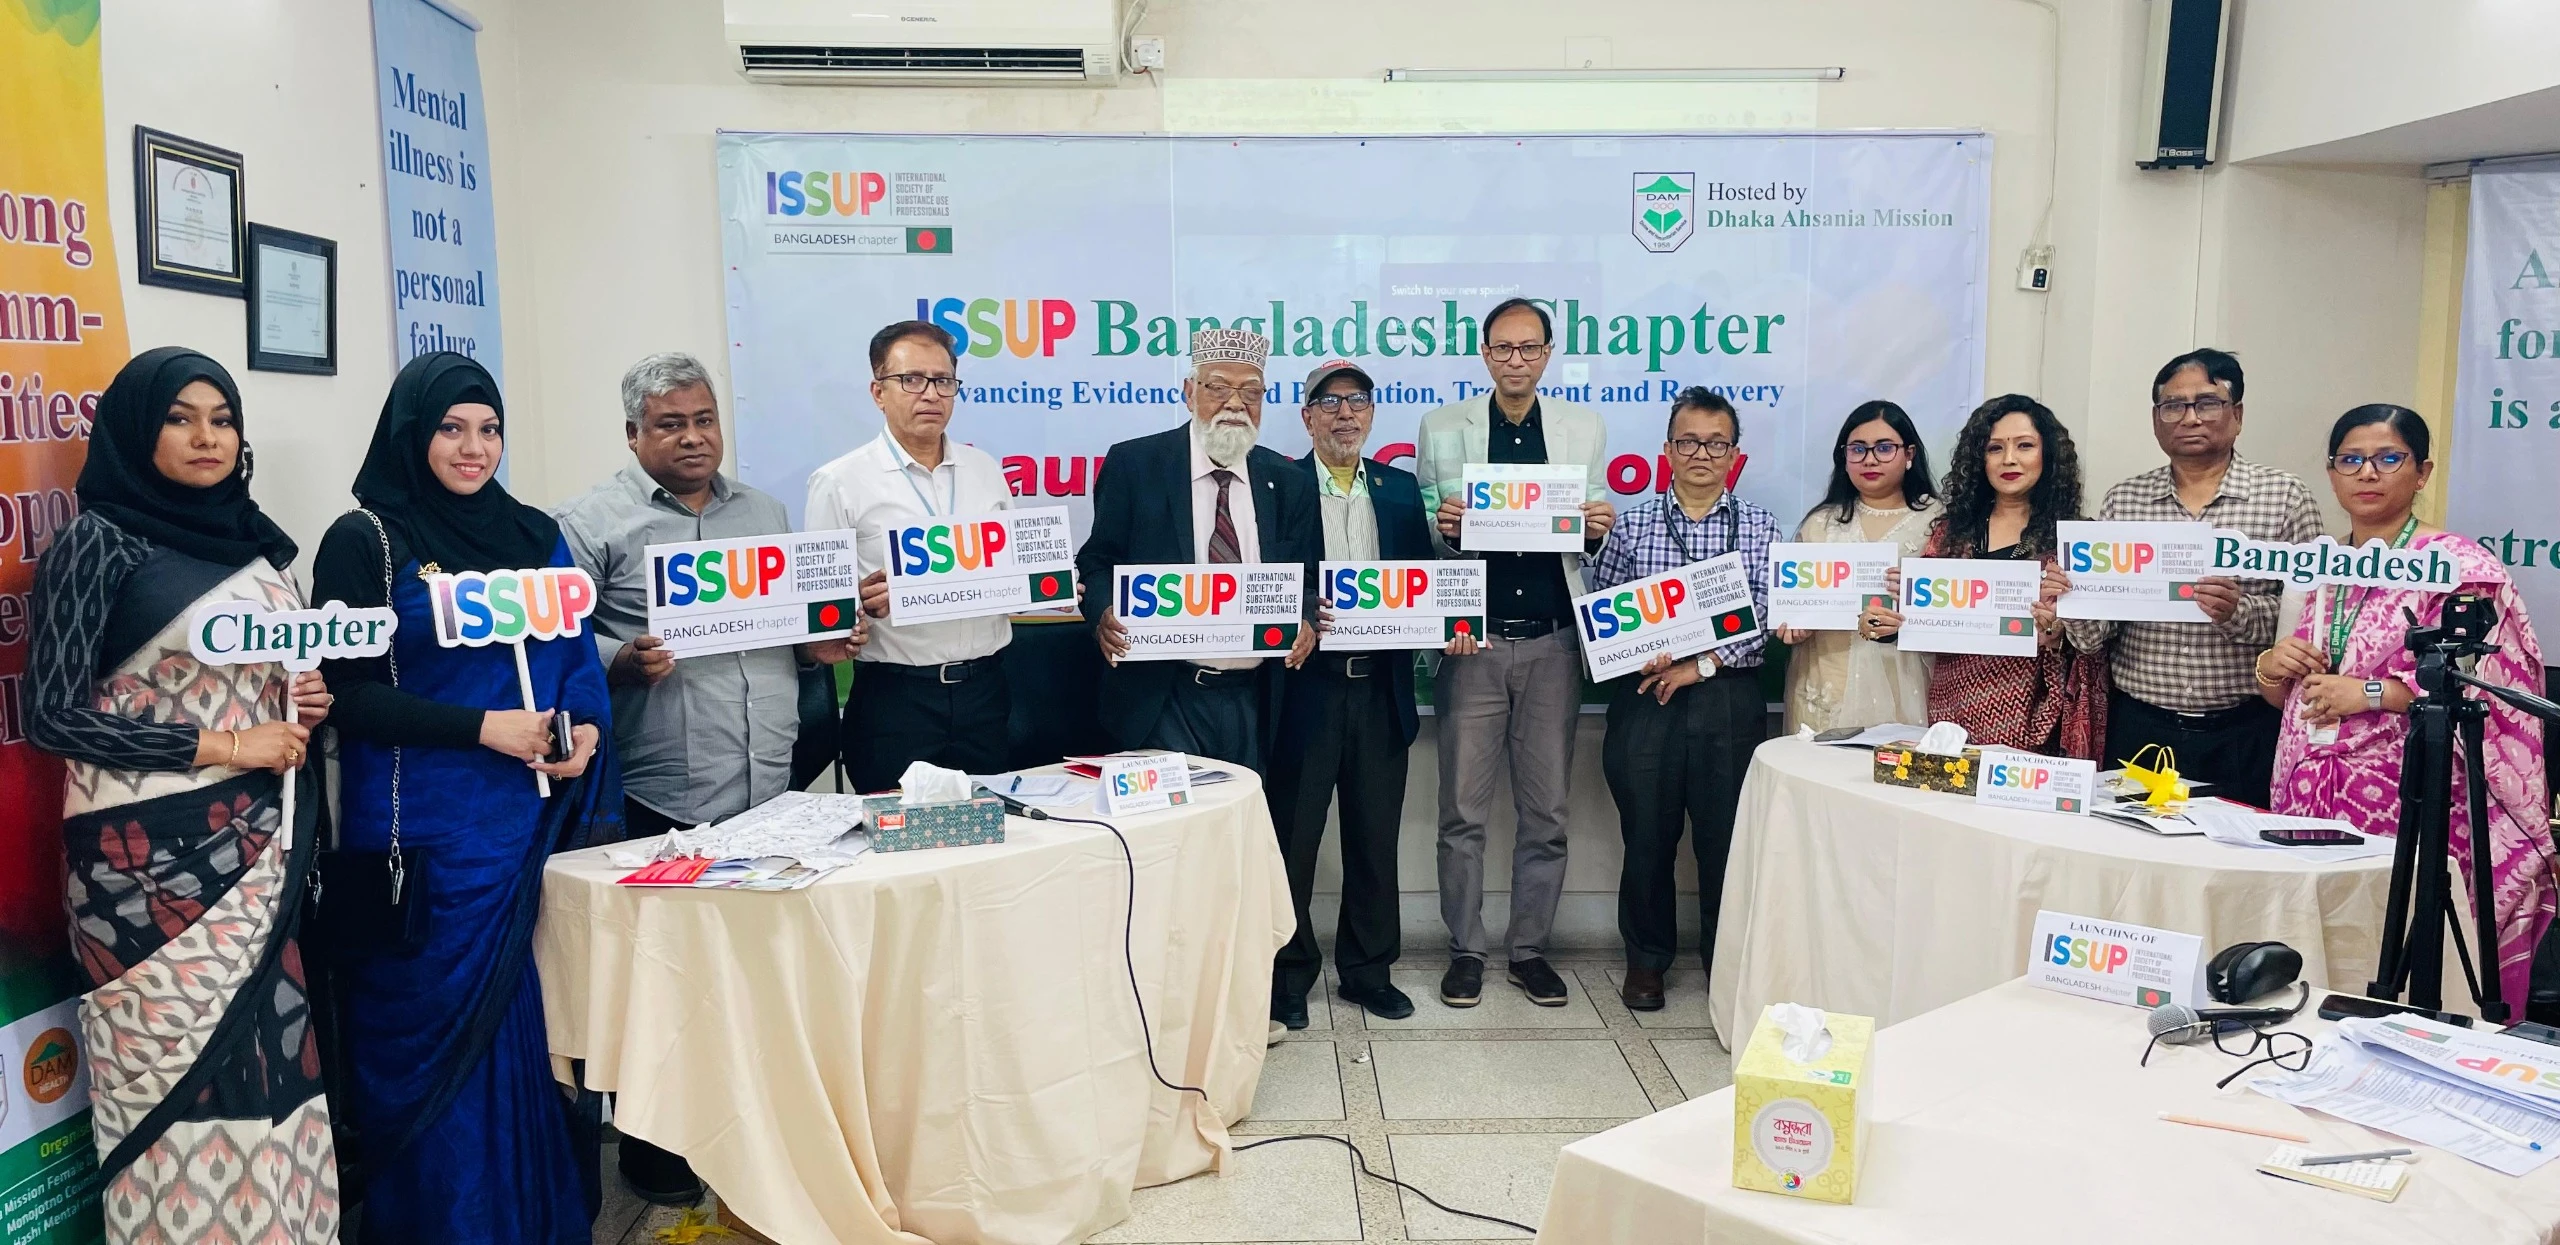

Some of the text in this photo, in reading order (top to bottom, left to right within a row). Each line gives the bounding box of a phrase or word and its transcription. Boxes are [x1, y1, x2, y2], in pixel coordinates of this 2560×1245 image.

[391, 66, 467, 130] Mental
[389, 129, 476, 190] illness is
[895, 172, 947, 182] INTERNATIONAL
[767, 171, 886, 216] ISSUP
[896, 184, 933, 194] SOCIETY OF
[1646, 193, 1680, 201] DAM
[1708, 182, 1807, 205] Hosted by
[896, 196, 949, 205] SUBSTANCE USE
[896, 207, 949, 217] PROFESSIONALS
[1707, 208, 1953, 228] Dhaka Ahsania Mission
[412, 208, 462, 245] not a
[774, 233, 898, 247] BANGLADESH chapter
[396, 269, 485, 309] personal
[1391, 284, 1421, 296] Switch
[1423, 286, 1434, 296] to
[1435, 287, 1457, 298] your
[1459, 287, 1477, 296] new
[410, 321, 476, 361] failure
[1092, 300, 1480, 358] Baladesh
[1524, 298, 1785, 372] hapter
[1601, 379, 1649, 402] and
[2488, 388, 2528, 429] is
[1467, 482, 1541, 510] ISSUP
[1014, 516, 1062, 528] INTERNATIONAL
[1470, 520, 1521, 528] BANGLADESH
[1016, 529, 1051, 541] SOCIETY OF
[795, 540, 849, 554] INTERNATIONAL
[889, 521, 1006, 576] ISSUP
[1017, 539, 1067, 552] SUBSTANCE USE
[2162, 543, 2203, 551] INTERNATIONAL
[796, 553, 836, 567] SOCIETY OF
[1018, 550, 1068, 563] PROFESSIONALS
[2063, 542, 2154, 574] ISSUP
[2213, 536, 2452, 585] Bangladesh
[654, 545, 785, 607] ISSUP
[797, 565, 852, 580] SUBSTANCE USE
[1246, 573, 1296, 582] INTERNATIONAL
[1437, 568, 1480, 577] INTERNATIONAL
[1691, 561, 1737, 581] INTERNATIONAL
[1774, 561, 1851, 589] ISSUP
[2162, 567, 2205, 576] PROFESSIONALS
[797, 577, 853, 592] PROFESSIONALS
[1246, 583, 1283, 593] SOCIETY OF
[1325, 568, 1429, 610] ISSUP
[1437, 579, 1469, 588] SOCIETY OF
[1693, 574, 1727, 590] SOCIETY OF
[1695, 582, 1743, 601] SUBSTANCE USE
[2131, 586, 2163, 595] chapter
[902, 585, 1022, 607] BANGLADESH chapter
[1120, 574, 1237, 618] ISSUP
[1246, 595, 1297, 604] SUBSTANCE USE
[1437, 589, 1481, 598] SUBSTANCE USE
[1437, 599, 1482, 608] PROFESSIONALS
[1698, 590, 1746, 610] PROFESSIONALS
[1906, 578, 1989, 609] ISSUP
[439, 574, 591, 640] ISSUP
[1246, 605, 1297, 615] PROFESSIONALS
[1580, 578, 1685, 642] ISSUP
[664, 616, 799, 641] BANGLADESH chapter
[1330, 625, 1438, 637] BANGLADESH chapter
[1908, 618, 1994, 629] BANGLADESH chapter
[202, 613, 386, 660] Chapter
[1125, 633, 1246, 645] BANGLADESH chapter
[1599, 628, 1707, 666] BANGLADESH chapter
[1122, 759, 1158, 769] LAUNCHING
[2005, 755, 2056, 765] LAUNCHING
[1112, 769, 1158, 796] ISSUP
[1987, 764, 2049, 789] ISSUP
[2070, 922, 2158, 944] LAUNCHING OF
[2044, 933, 2127, 974] ISSUP
[2045, 974, 2132, 997] BANGLADESH chapter
[31, 1055, 74, 1085] DAM
[39, 1075, 69, 1095] HEALTH
[4, 1183, 45, 1215] Mission
[43, 1203, 80, 1233] Mental
